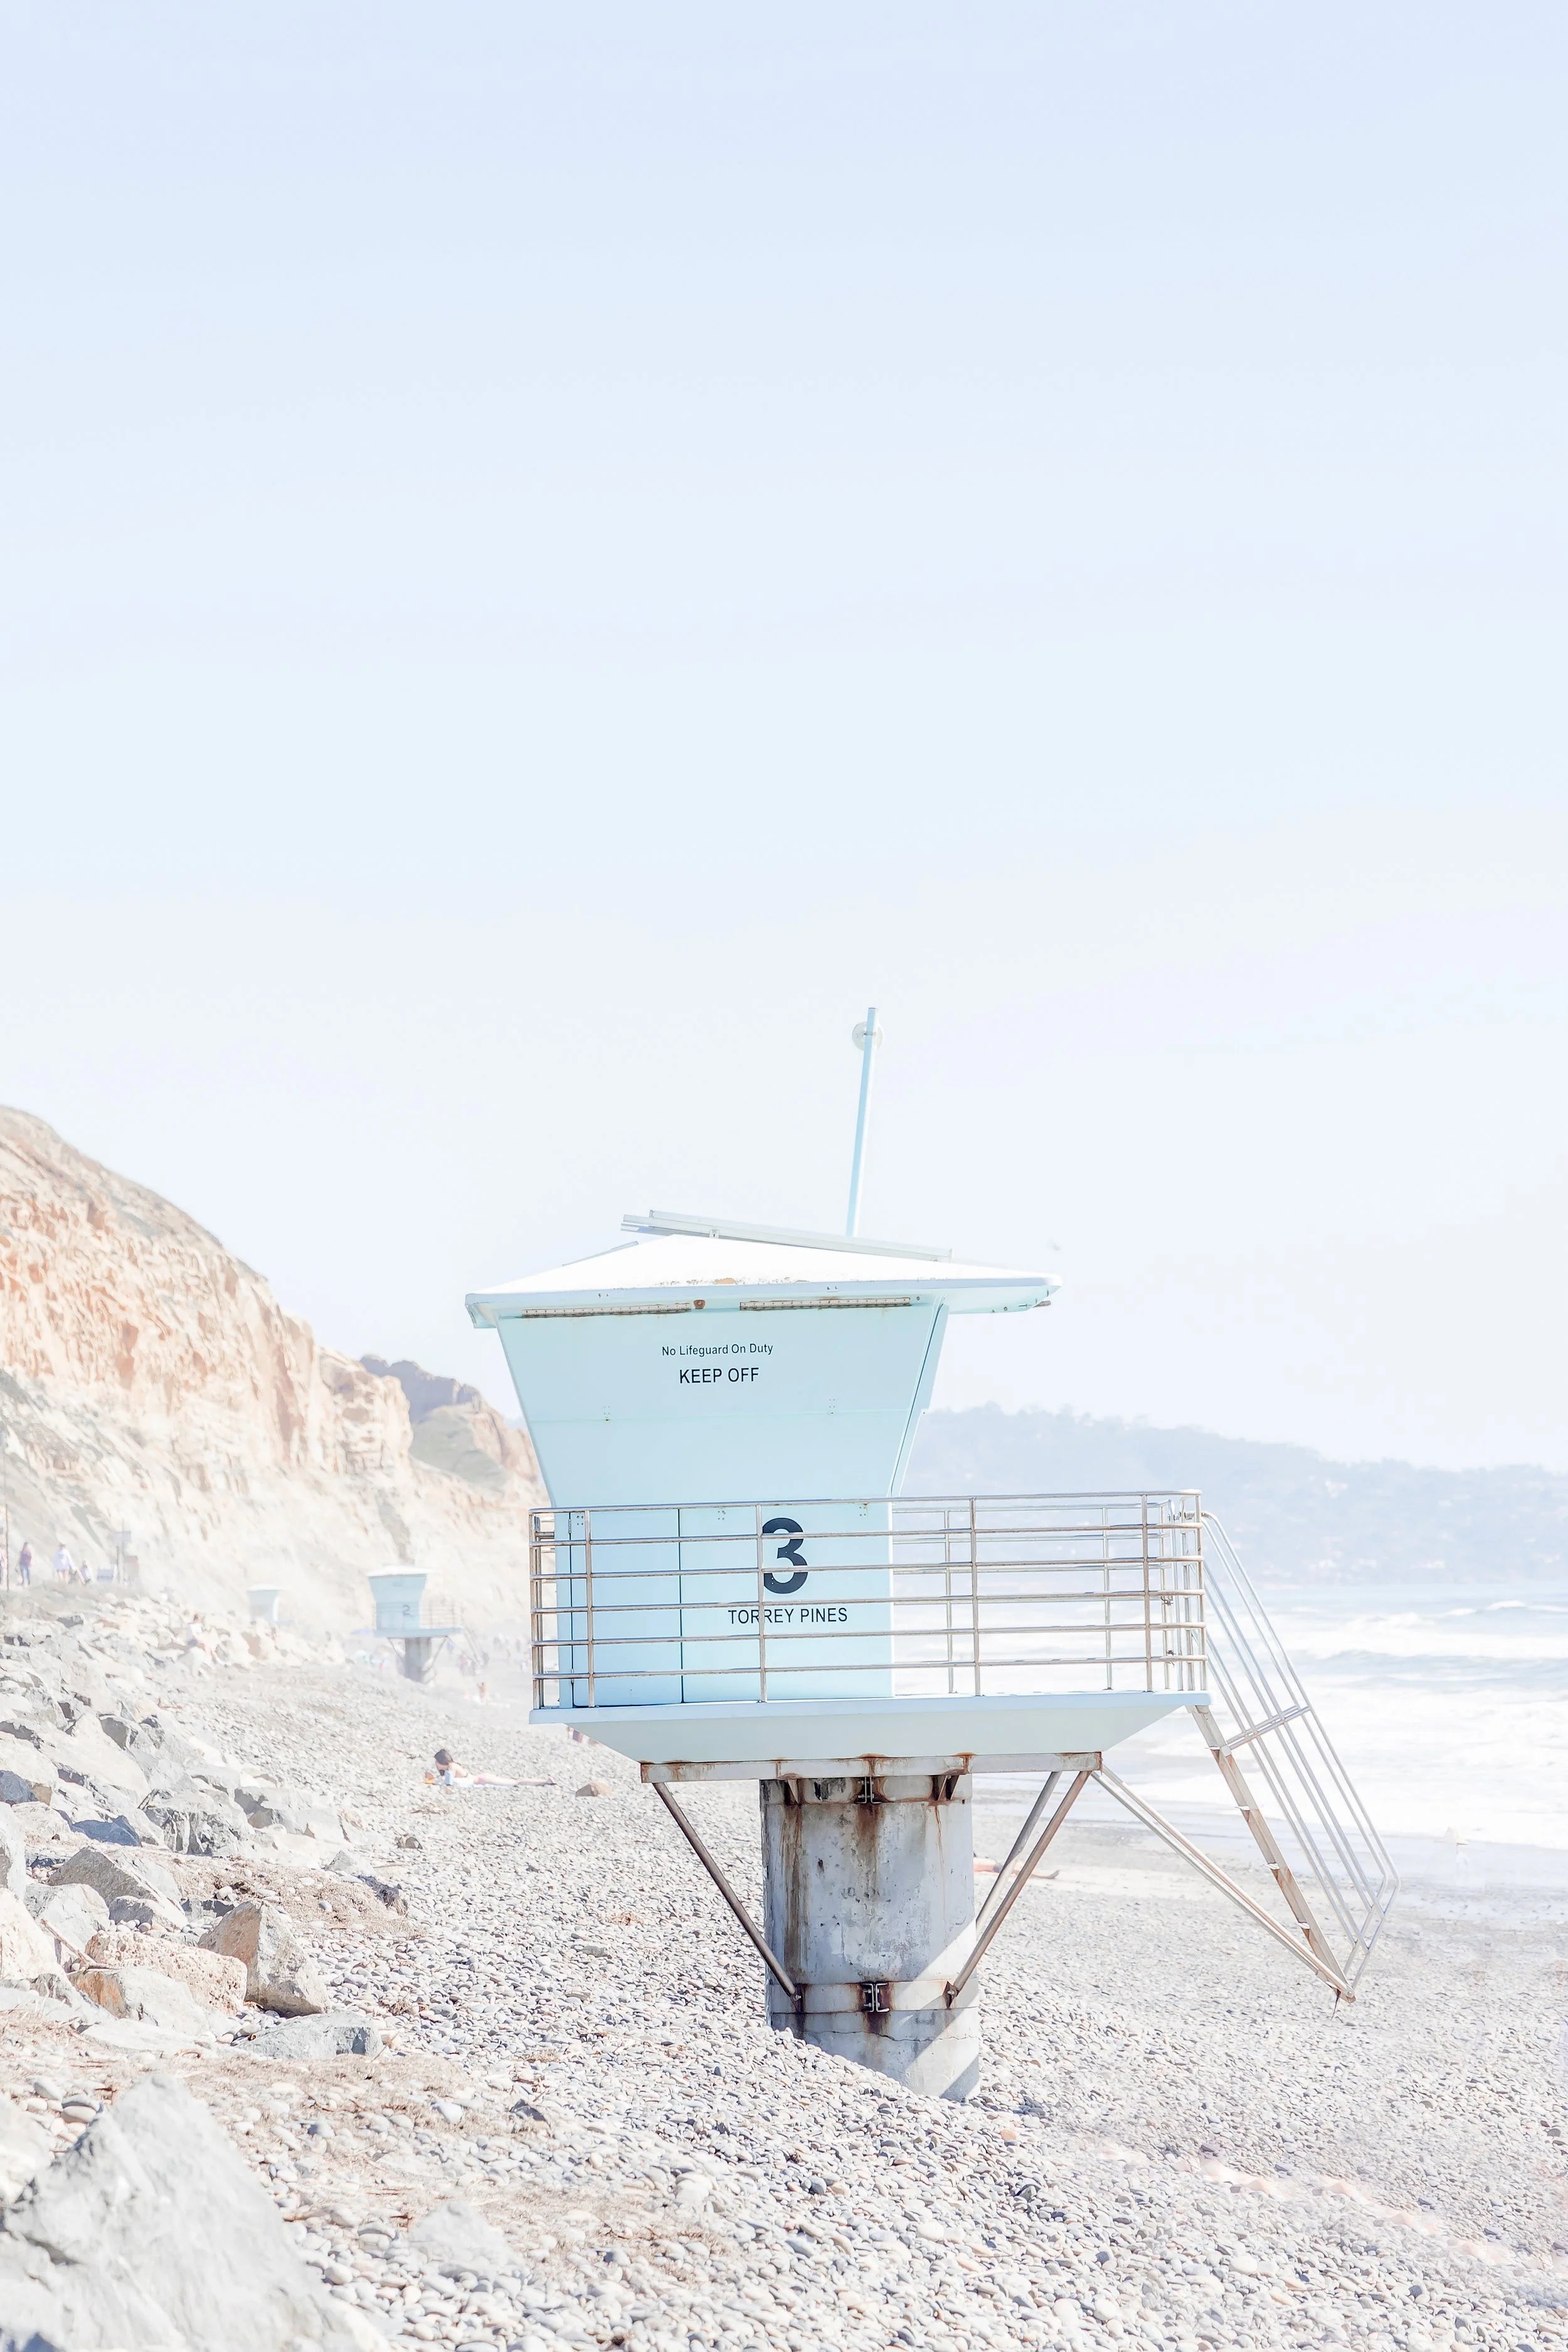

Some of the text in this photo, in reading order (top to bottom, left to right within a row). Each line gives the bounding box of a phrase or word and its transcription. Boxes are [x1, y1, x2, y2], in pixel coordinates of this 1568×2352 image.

[662, 1343, 773, 1357] No Lifeguard On Duty
[680, 1367, 760, 1384] KEEP OFF
[762, 1517, 808, 1594] 3
[402, 1604, 413, 1616] 2
[728, 1608, 848, 1624] TORREY PINES
